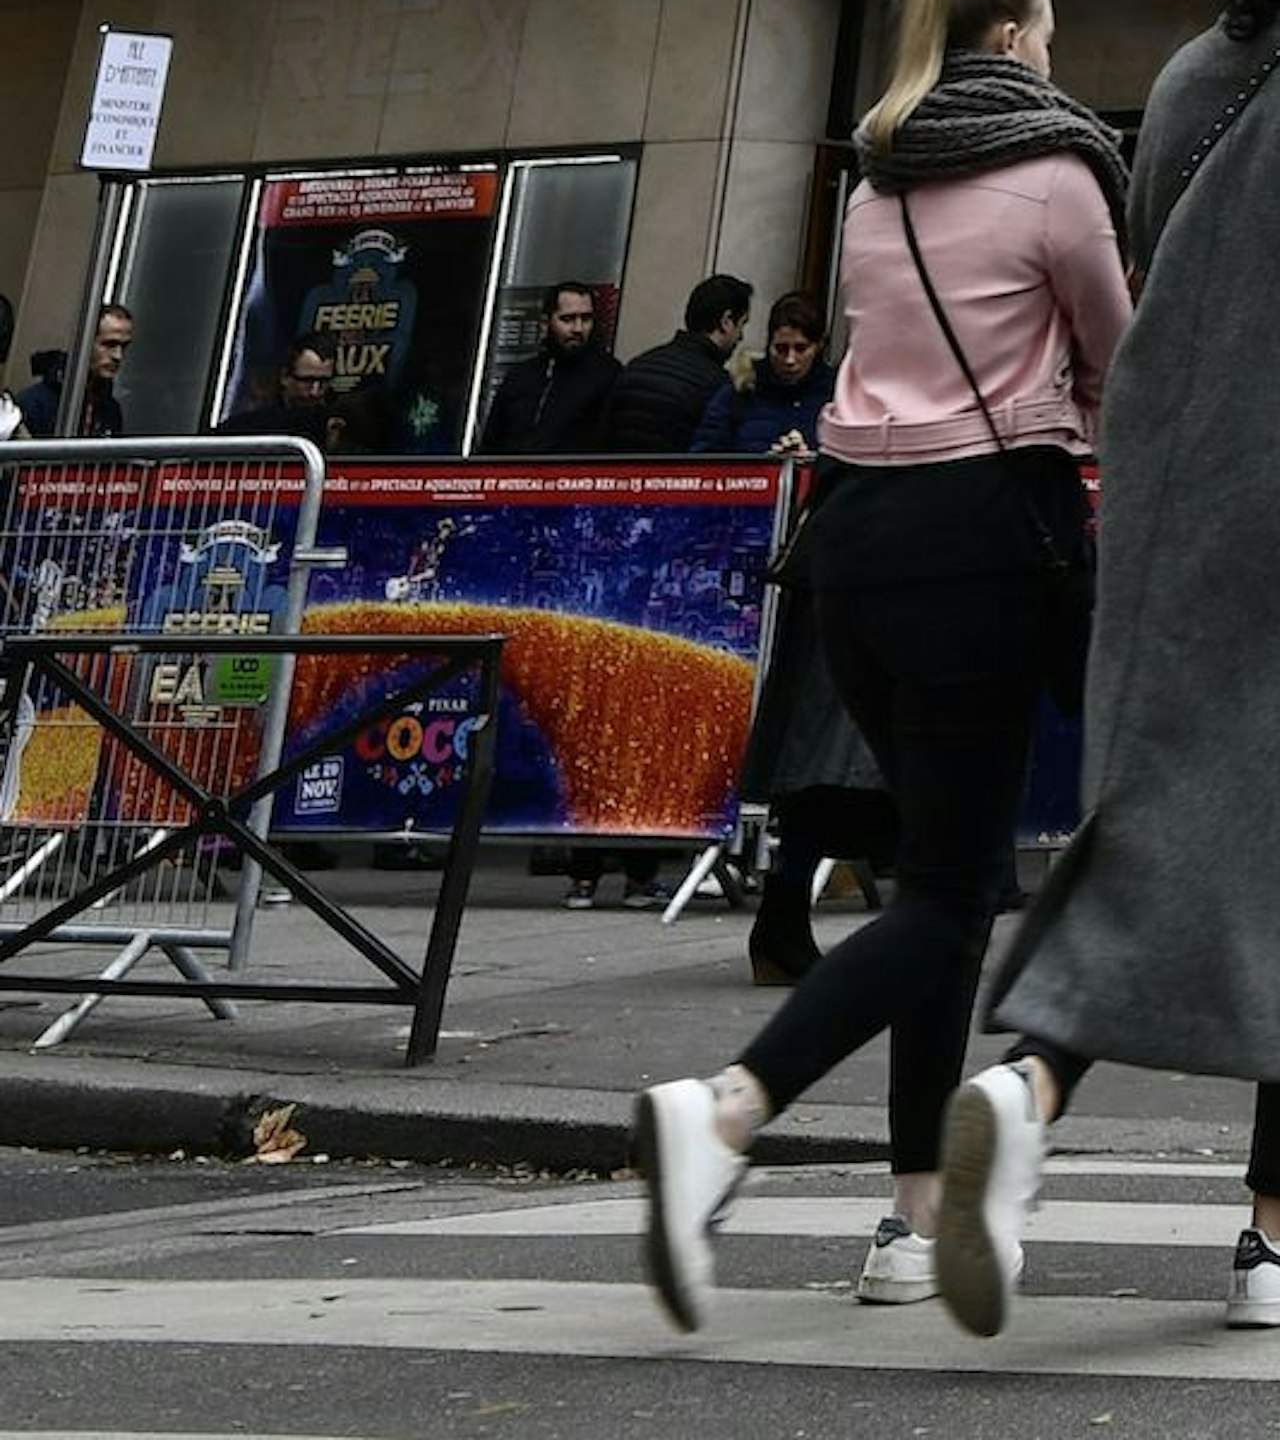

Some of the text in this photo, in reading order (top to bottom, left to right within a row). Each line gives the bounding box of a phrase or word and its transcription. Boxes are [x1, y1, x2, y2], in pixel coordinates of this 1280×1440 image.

[334, 342, 391, 376] AUX
[371, 479, 424, 492] SPECTACLE
[498, 479, 543, 491] MUSICAL
[557, 478, 594, 491] GRAND
[594, 478, 616, 491] REX
[643, 478, 700, 491] NOVEMBRE
[724, 478, 769, 491] JANVIER
[428, 699, 468, 712] PIXAR
